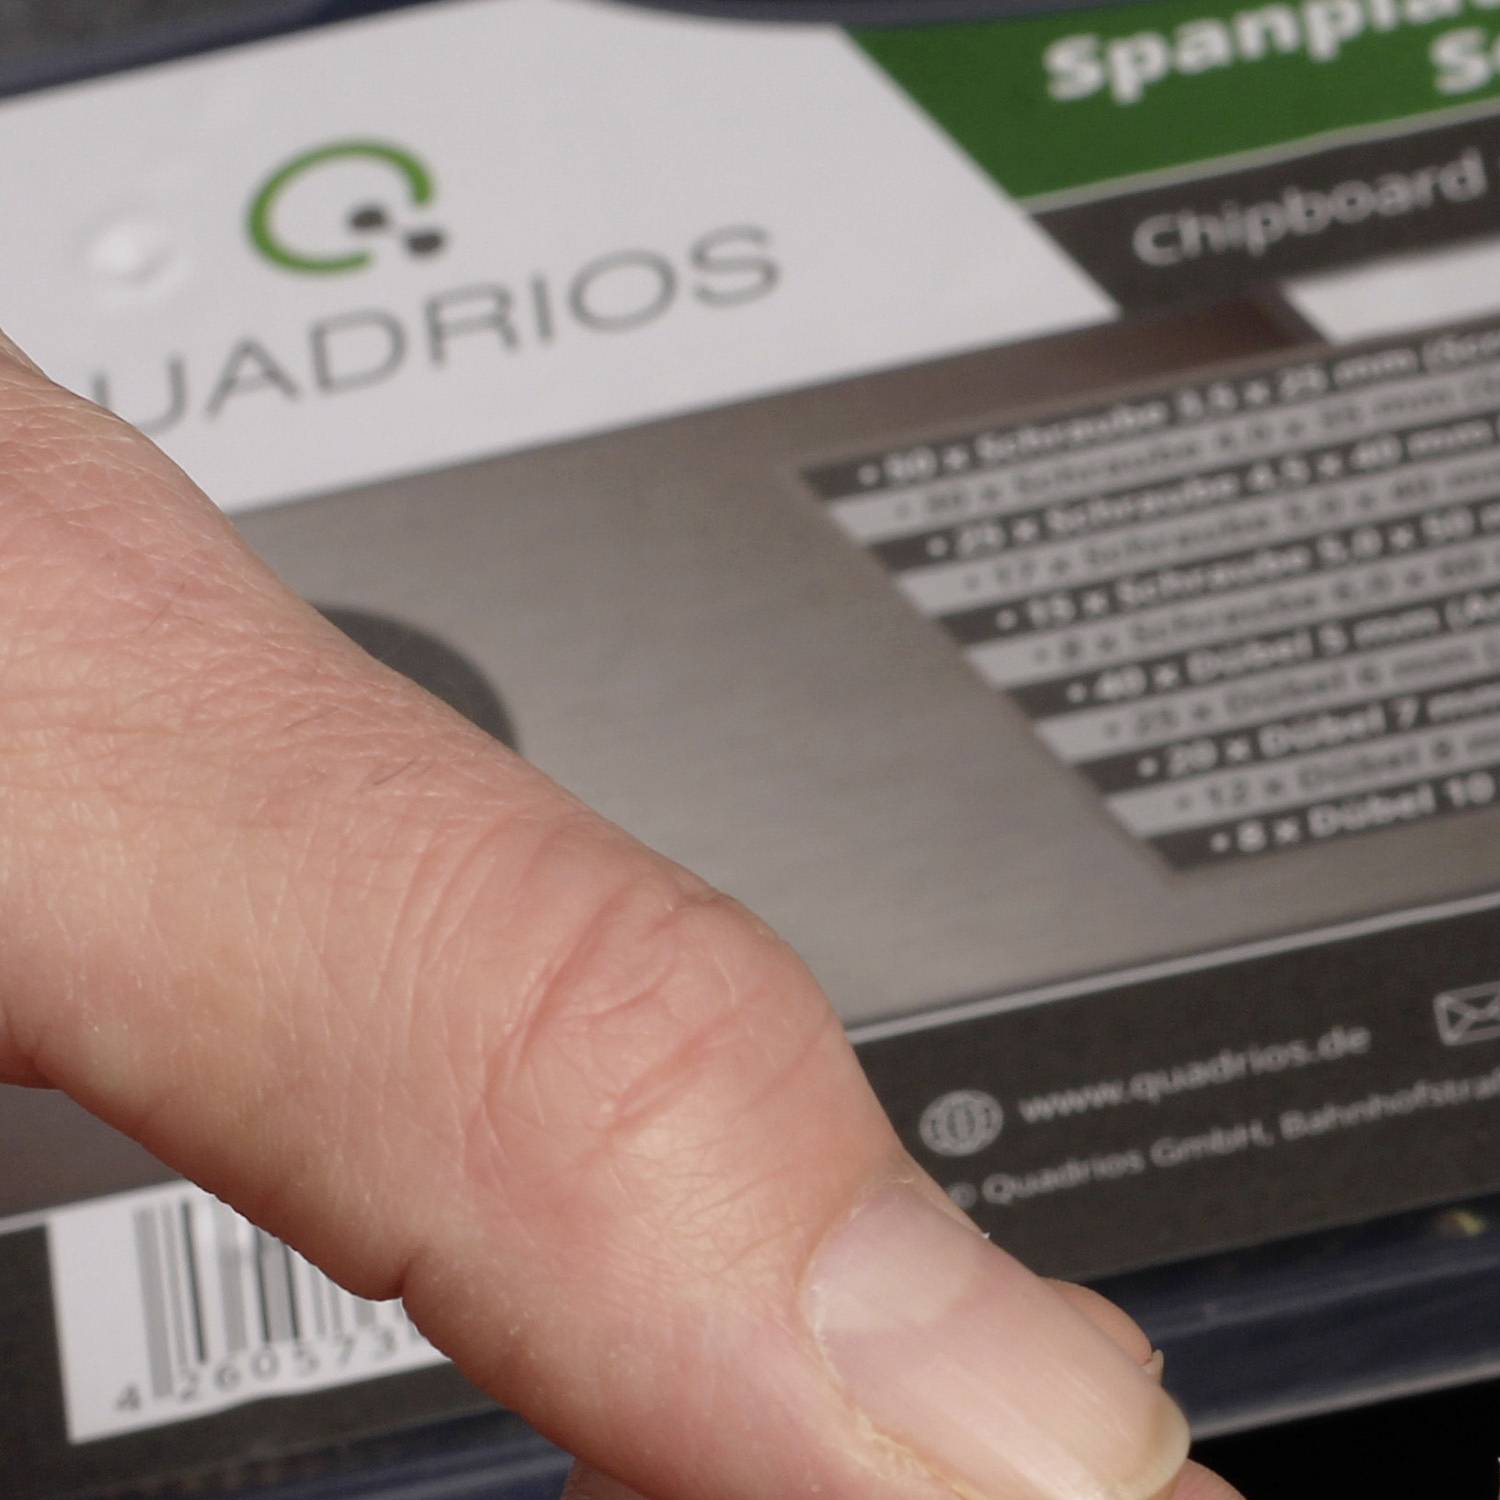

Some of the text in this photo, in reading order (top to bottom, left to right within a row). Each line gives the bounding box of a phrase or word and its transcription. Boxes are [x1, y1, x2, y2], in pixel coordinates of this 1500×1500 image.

[1132, 150, 1487, 268] Chipboard
[92, 224, 780, 437] UADRIOS
[976, 397, 1168, 466] Schraube
[1335, 347, 1415, 388] mm
[1044, 468, 1241, 538] Schraube
[1408, 417, 1492, 459] mm
[1114, 540, 1312, 611] Schraube
[1353, 606, 1440, 648] mm
[1019, 1026, 1372, 1122] www.quadrios.de
[982, 1149, 1145, 1204] Quadrios
[1150, 1120, 1274, 1167] GmbH,
